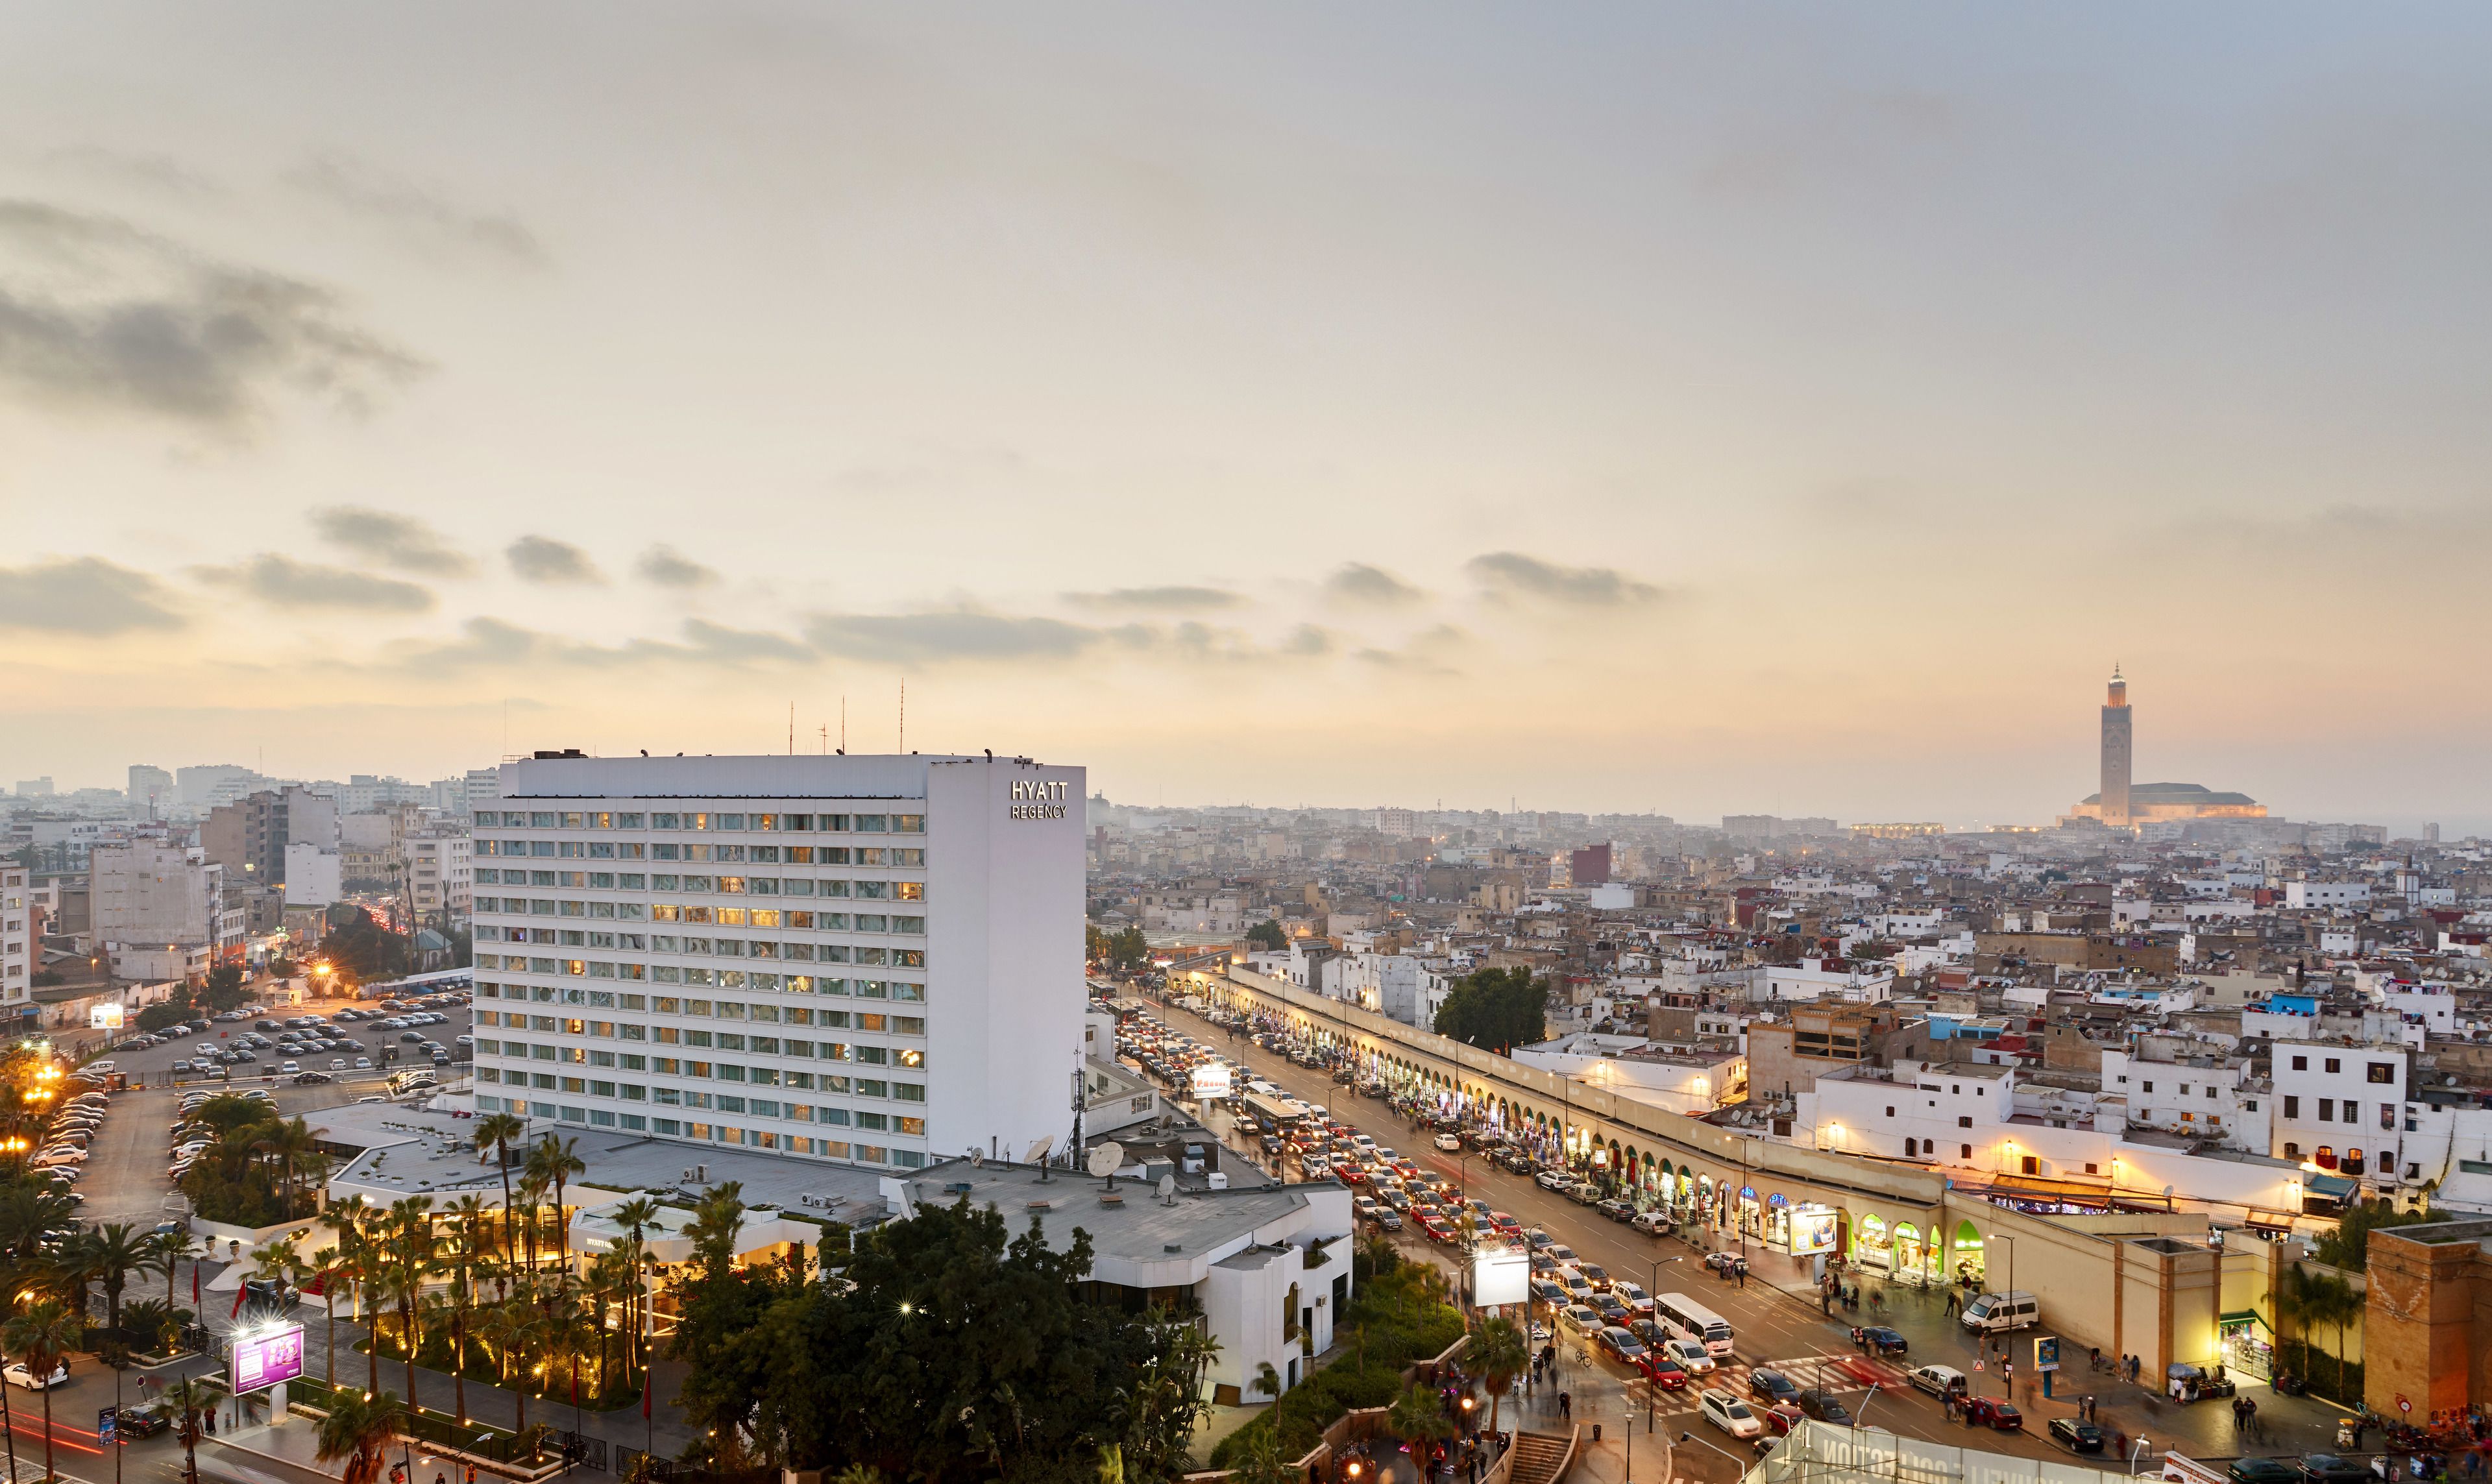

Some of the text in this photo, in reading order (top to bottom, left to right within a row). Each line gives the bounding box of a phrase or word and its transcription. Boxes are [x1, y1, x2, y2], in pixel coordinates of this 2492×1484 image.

[1011, 781, 1068, 800] HYATT
[1011, 805, 1068, 819] REGENCY
[587, 1237, 604, 1247] HYATT
[2171, 1460, 2192, 1473] Location
[2198, 1472, 2216, 1484] Voiture
